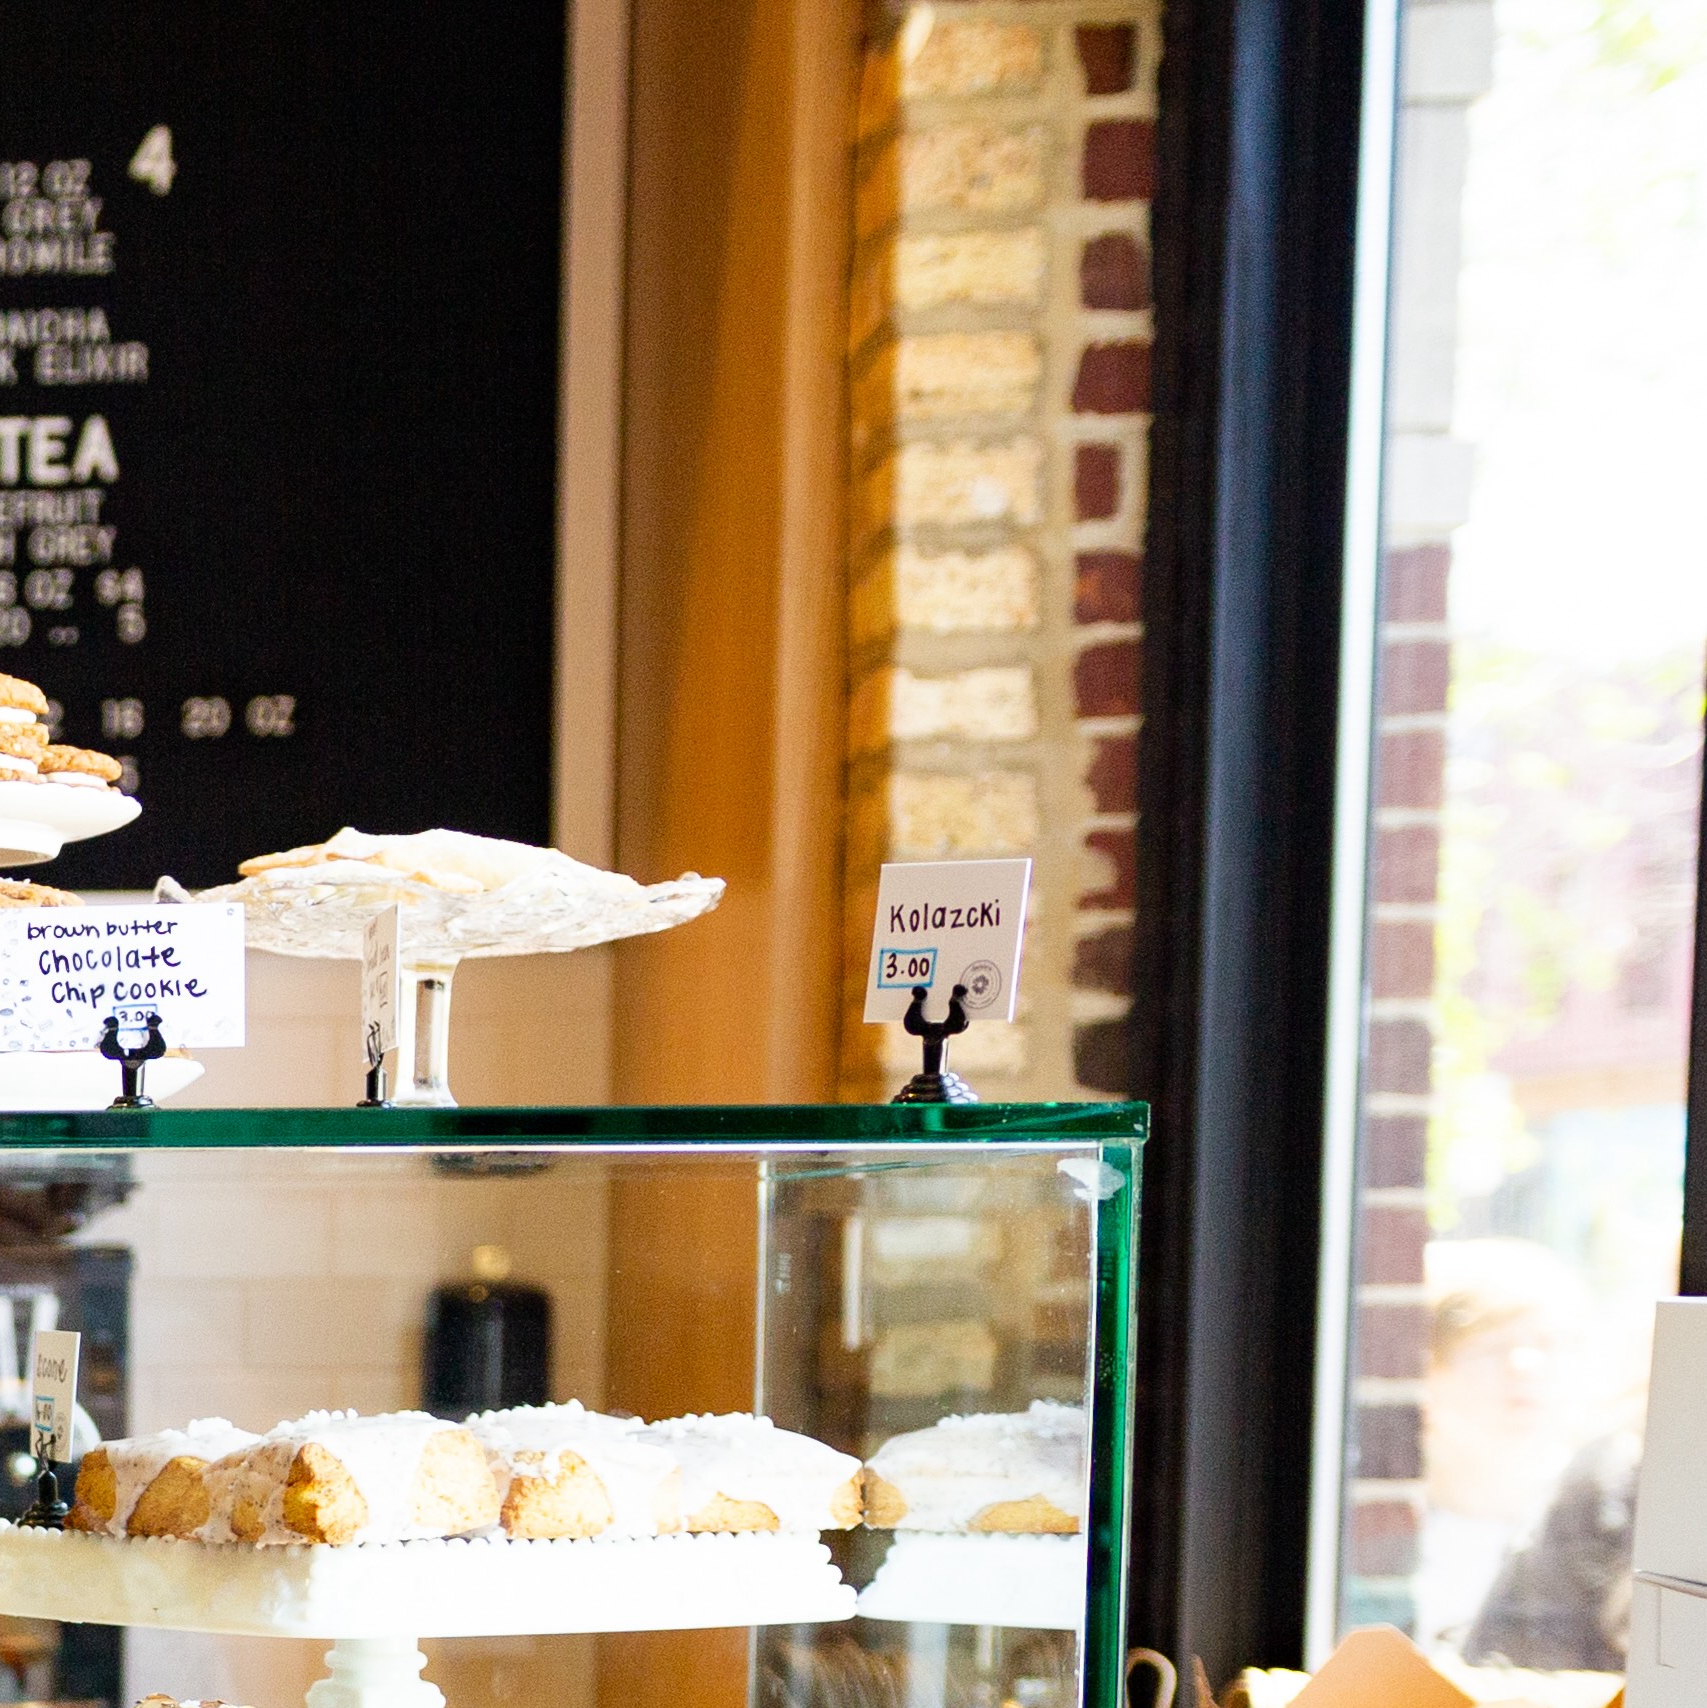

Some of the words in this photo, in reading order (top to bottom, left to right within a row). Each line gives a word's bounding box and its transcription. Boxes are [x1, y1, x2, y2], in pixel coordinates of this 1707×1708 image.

[42, 158, 92, 198] OZ
[127, 124, 177, 196] 4
[2, 196, 103, 236] GREY
[34, 341, 150, 385] ELIXIR
[27, 524, 116, 564] GREY
[23, 569, 75, 609] OZ
[100, 697, 144, 739] 16
[180, 696, 232, 739] 20
[245, 695, 296, 738] OZ
[27, 922, 100, 940] brown
[107, 920, 178, 936] butter
[886, 952, 930, 979] 3.00
